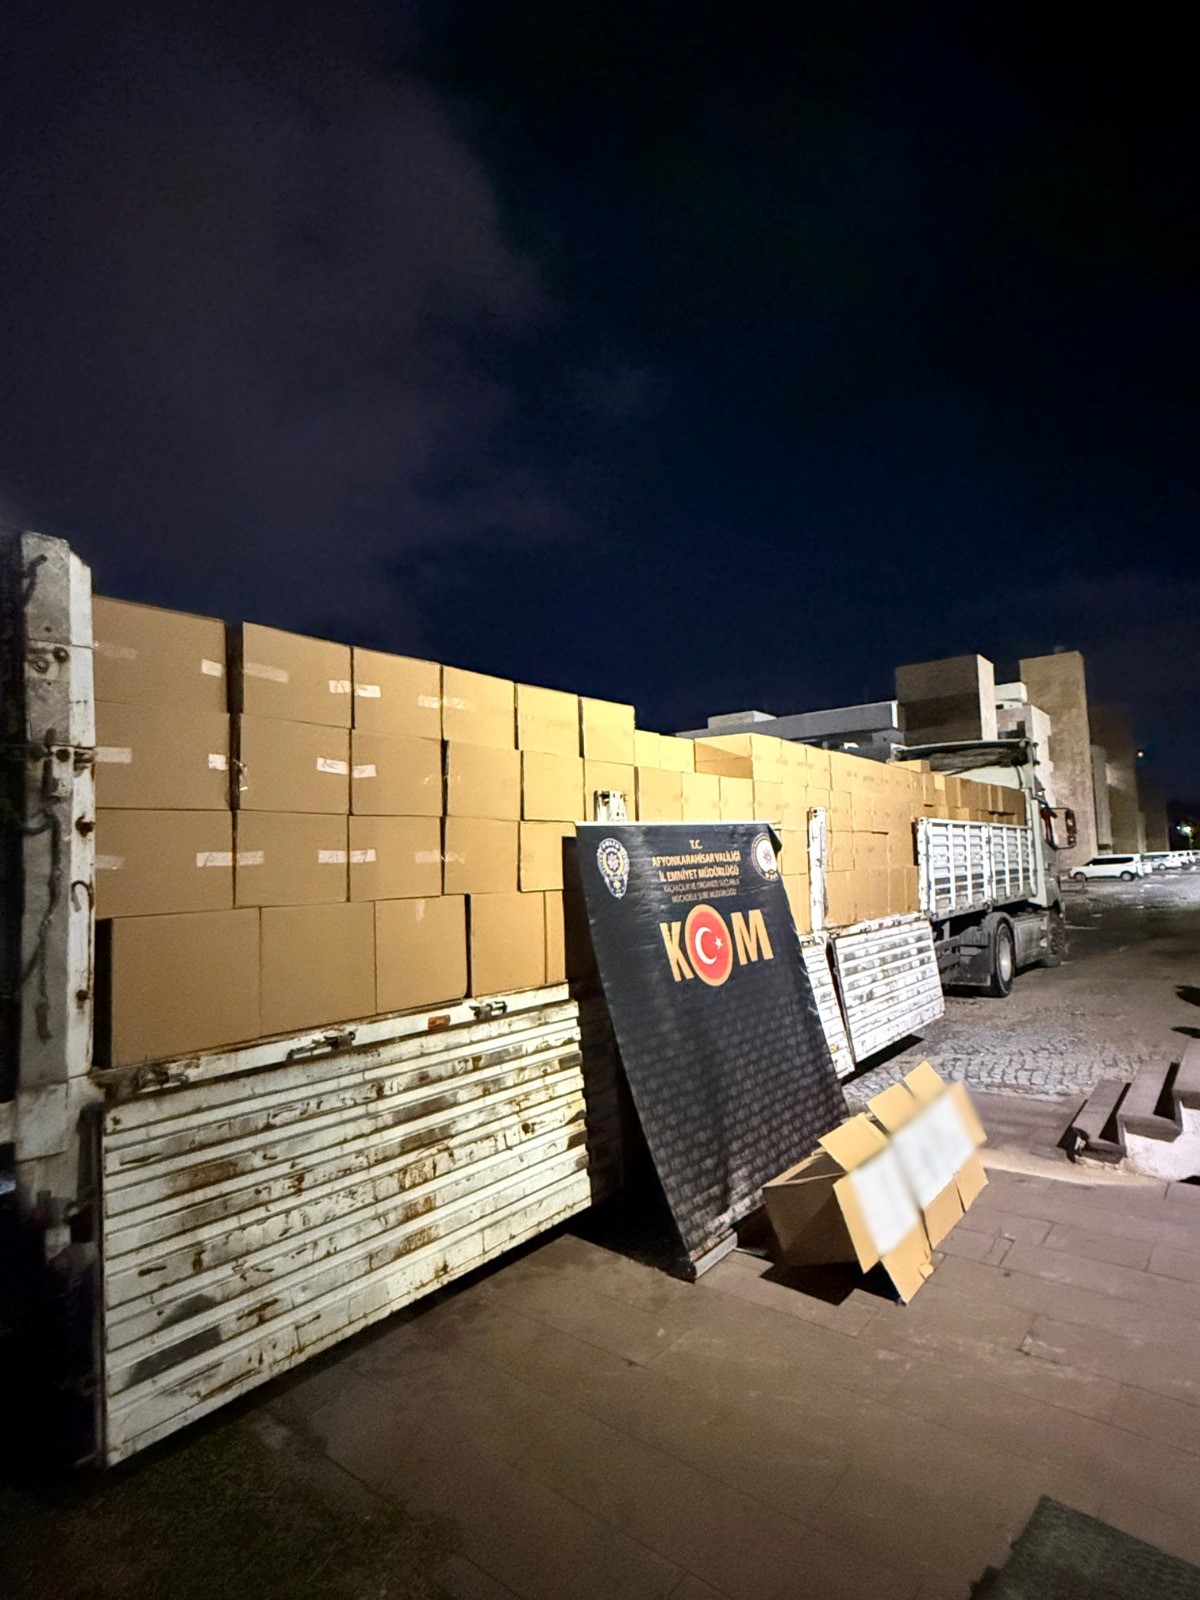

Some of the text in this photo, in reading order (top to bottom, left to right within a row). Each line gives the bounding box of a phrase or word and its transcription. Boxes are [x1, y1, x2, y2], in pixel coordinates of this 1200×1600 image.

[689, 839, 703, 849] T.C.
[652, 850, 741, 867] AFYONKARAHİSAR VALİLİĞİ
[667, 868, 697, 881] EMNİYET
[698, 864, 739, 878] MÜDÜRLÜĞÜ
[660, 904, 774, 987] KOM
